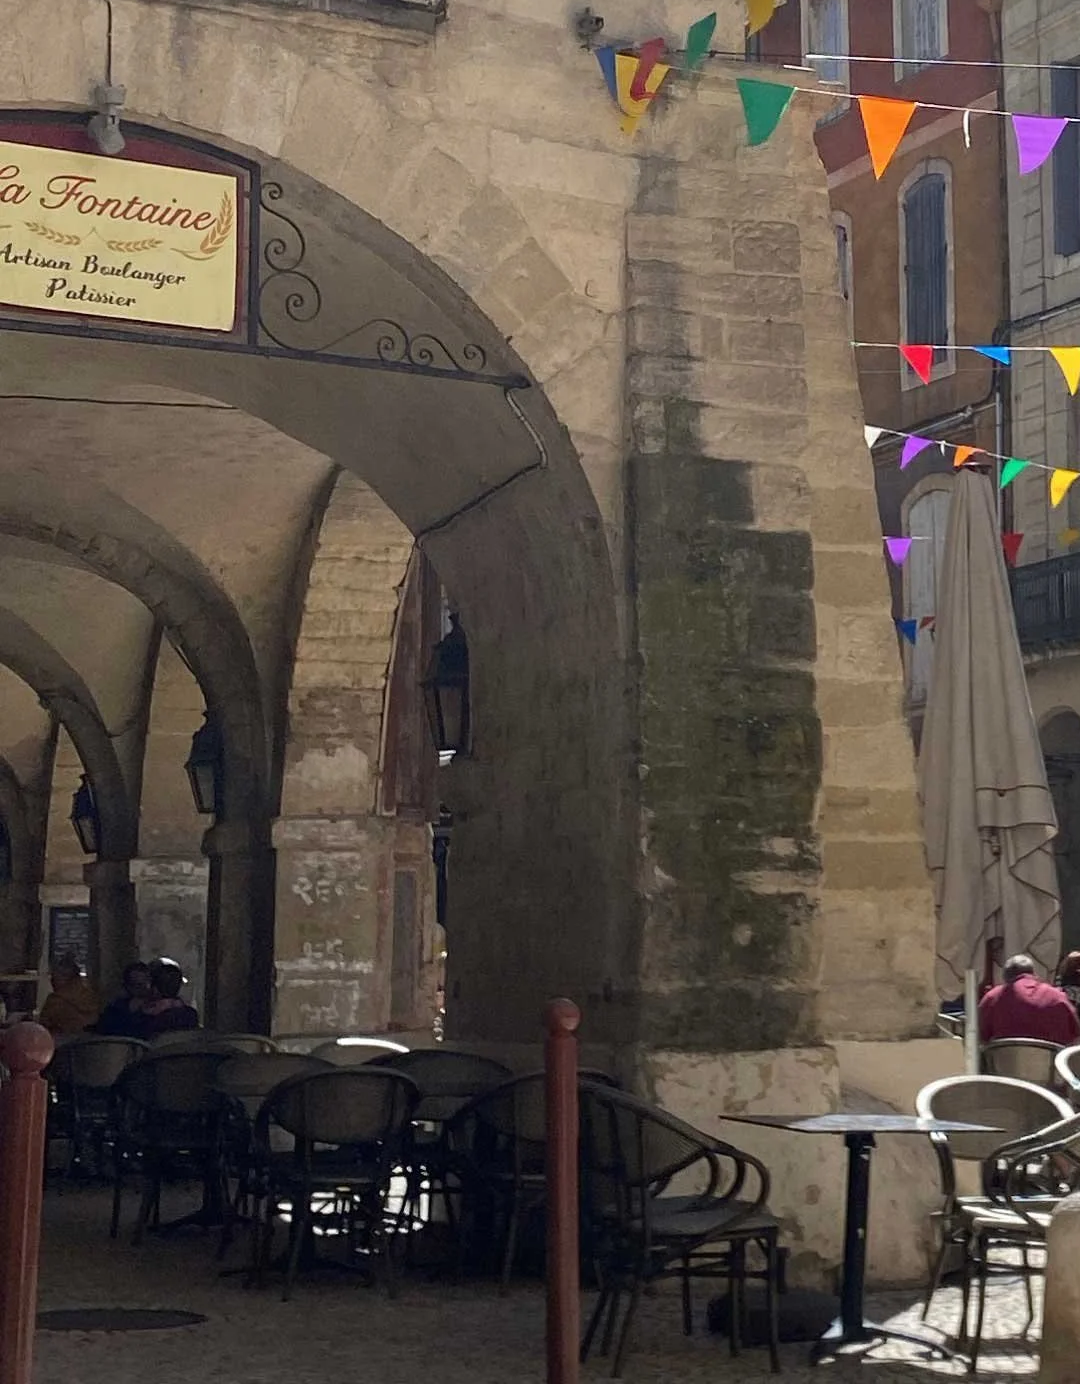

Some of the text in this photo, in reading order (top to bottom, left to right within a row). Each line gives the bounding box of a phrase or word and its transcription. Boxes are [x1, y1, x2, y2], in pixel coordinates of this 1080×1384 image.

[40, 175, 217, 231] Fontaine
[80, 254, 187, 289] Boulanger
[45, 278, 137, 307] Patissier
